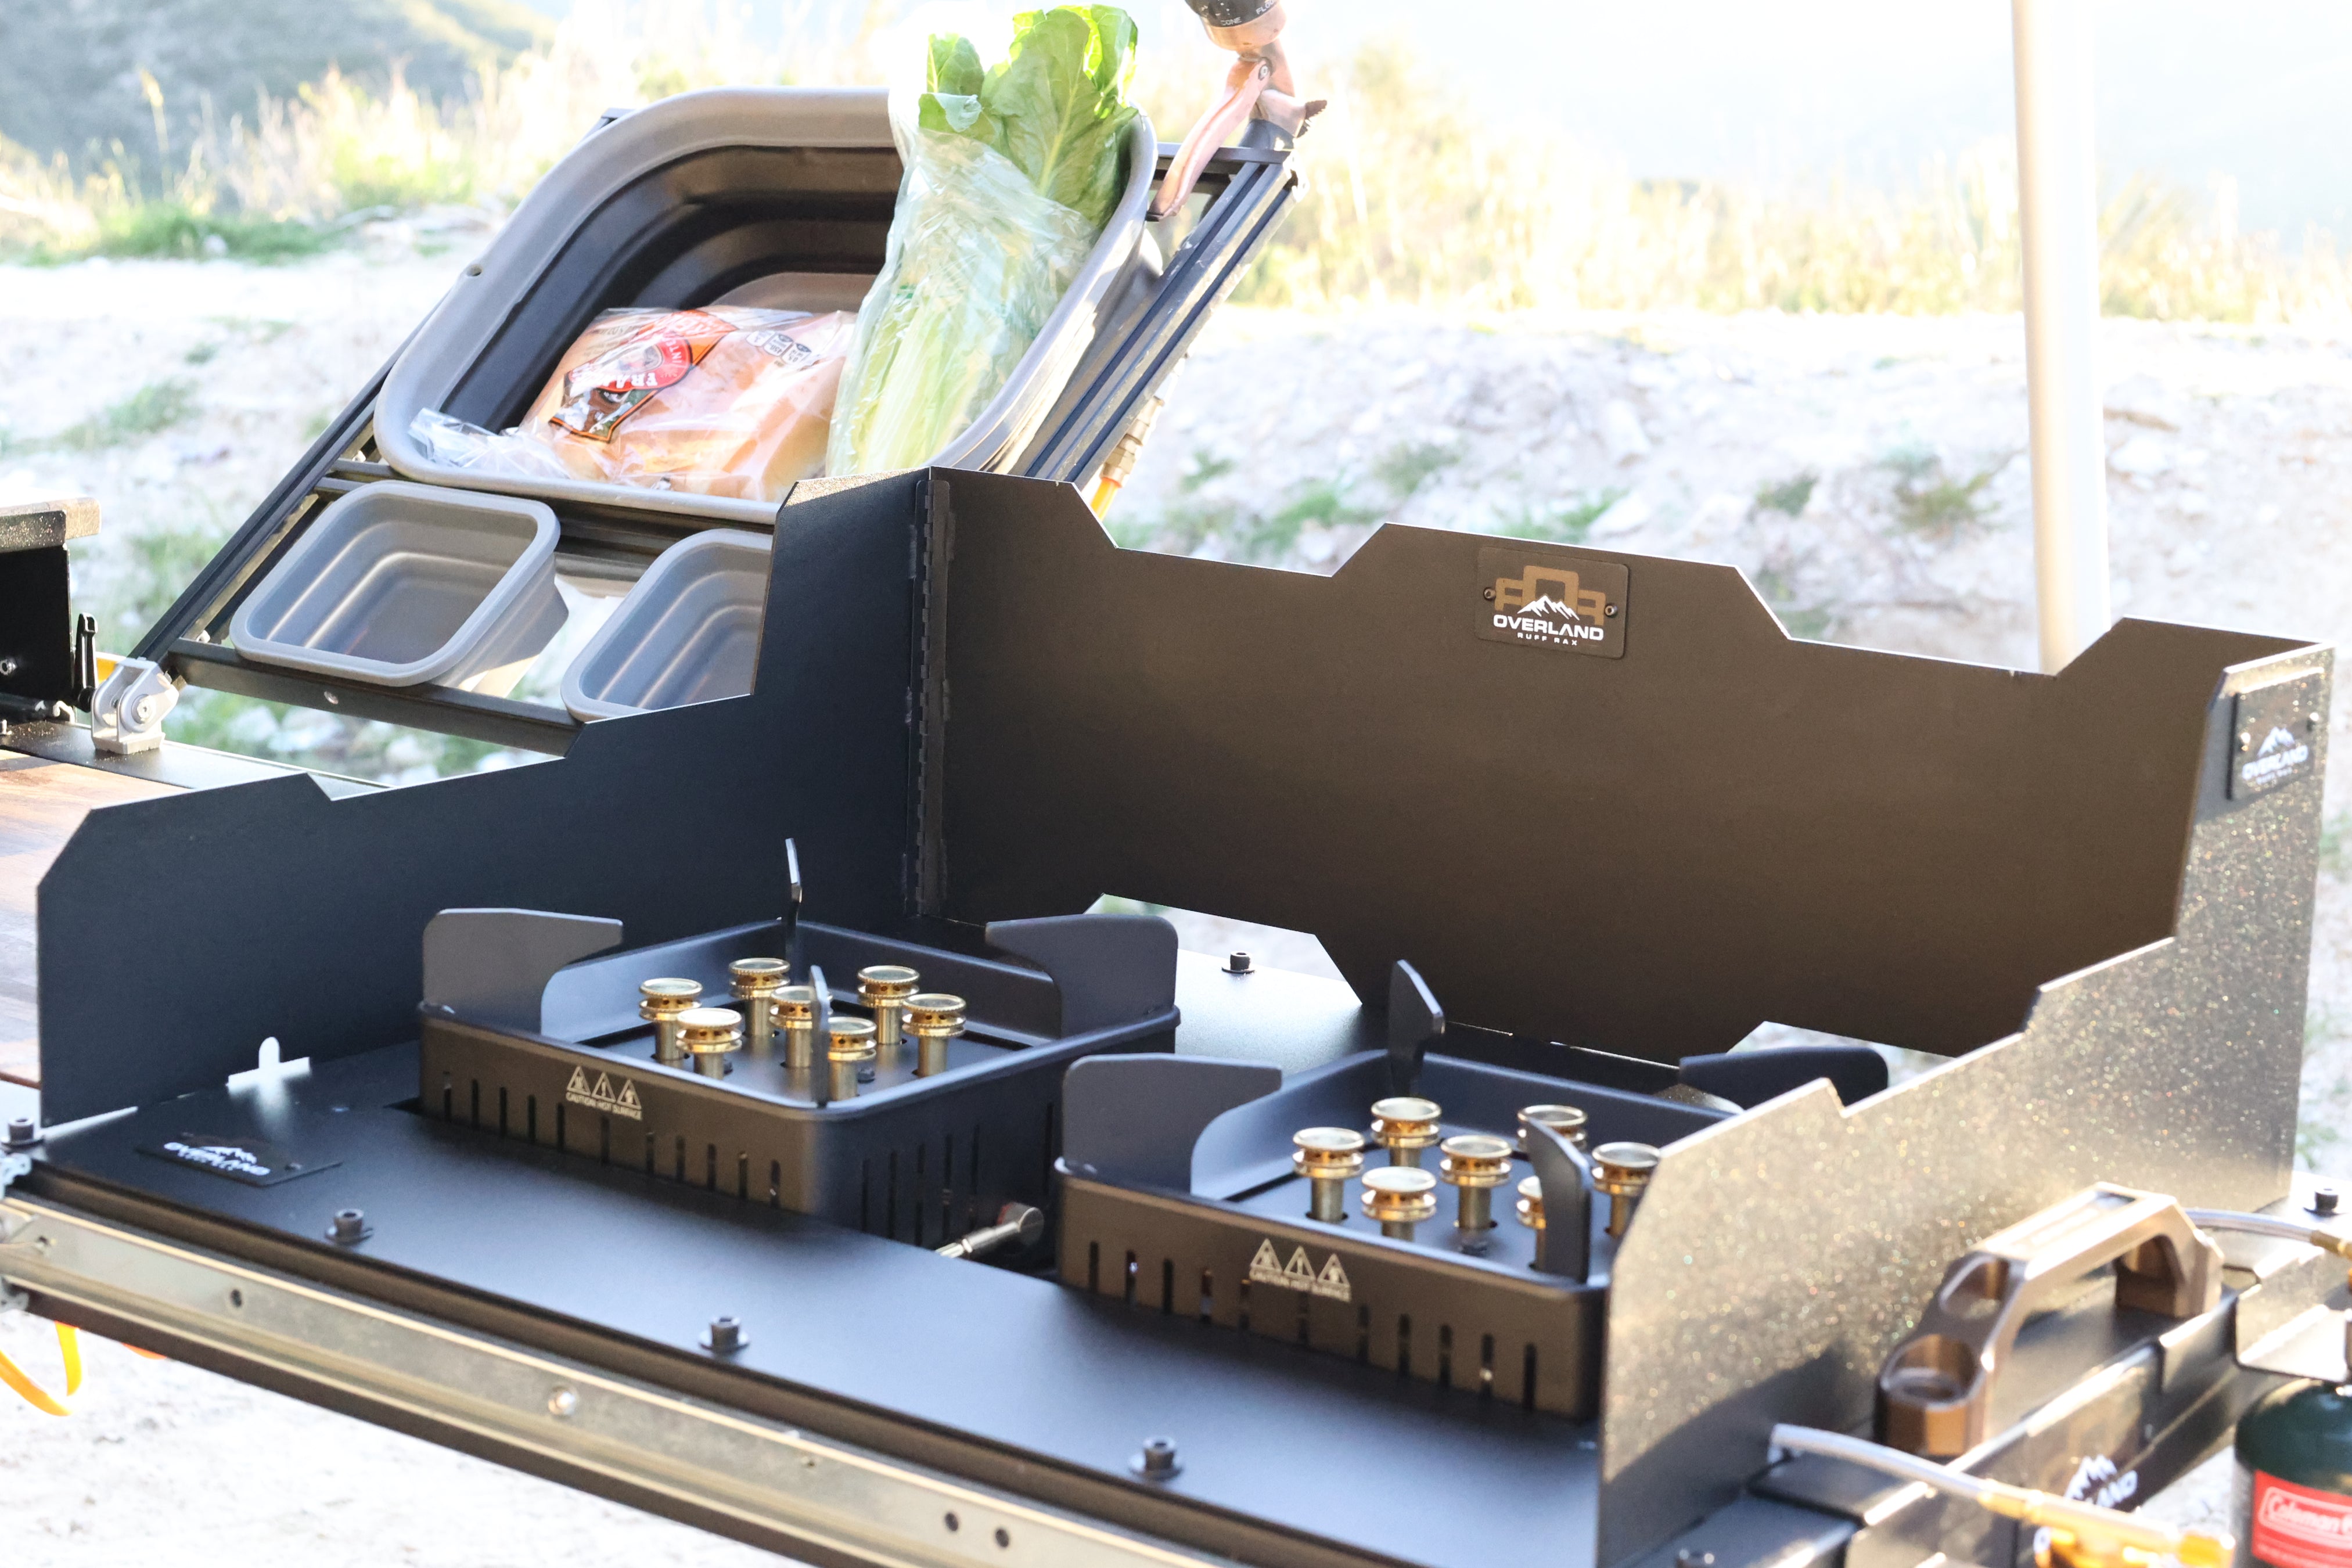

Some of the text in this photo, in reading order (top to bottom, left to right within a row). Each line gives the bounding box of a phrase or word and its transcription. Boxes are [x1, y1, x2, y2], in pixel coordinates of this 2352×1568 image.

[1256, 0, 1275, 15] FLOO
[1220, 17, 1242, 26] CONE
[1493, 614, 1604, 641] OVERLAND
[1517, 632, 1578, 646] RUFF RAX
[2268, 1495, 2340, 1533] Coleman
